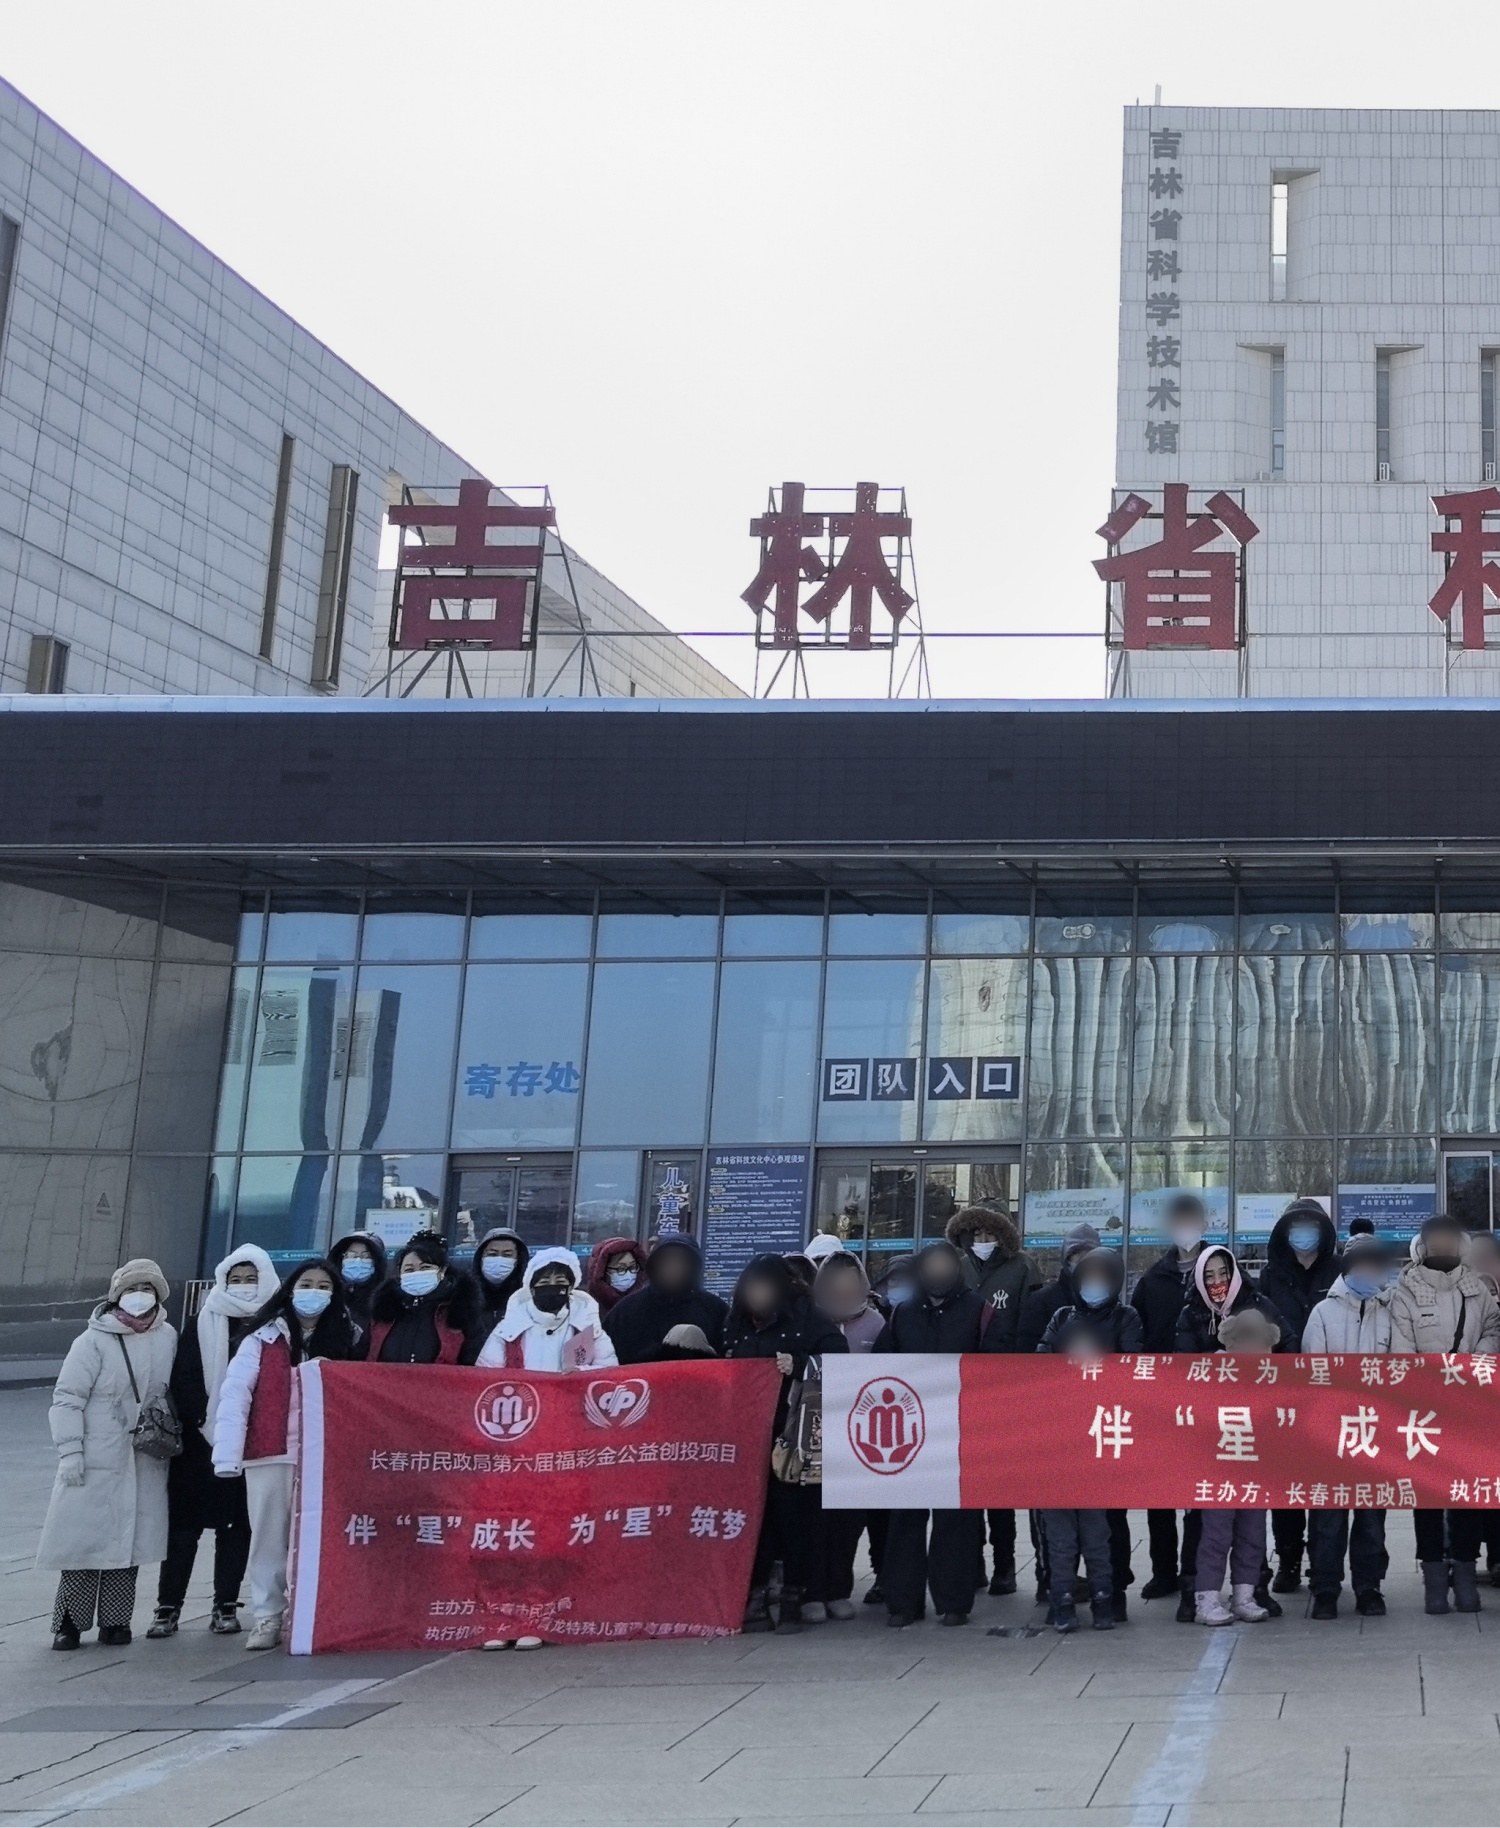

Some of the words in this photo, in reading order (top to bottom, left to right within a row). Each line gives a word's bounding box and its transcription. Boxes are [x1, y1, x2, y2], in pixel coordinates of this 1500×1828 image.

[1144, 127, 1183, 455] 吉林省科学技术馆
[464, 1061, 581, 1099] 寄存处
[827, 1061, 1016, 1097] 团队入口
[369, 1442, 737, 1473] 长春市民政局第六届福彩金公益创投项目
